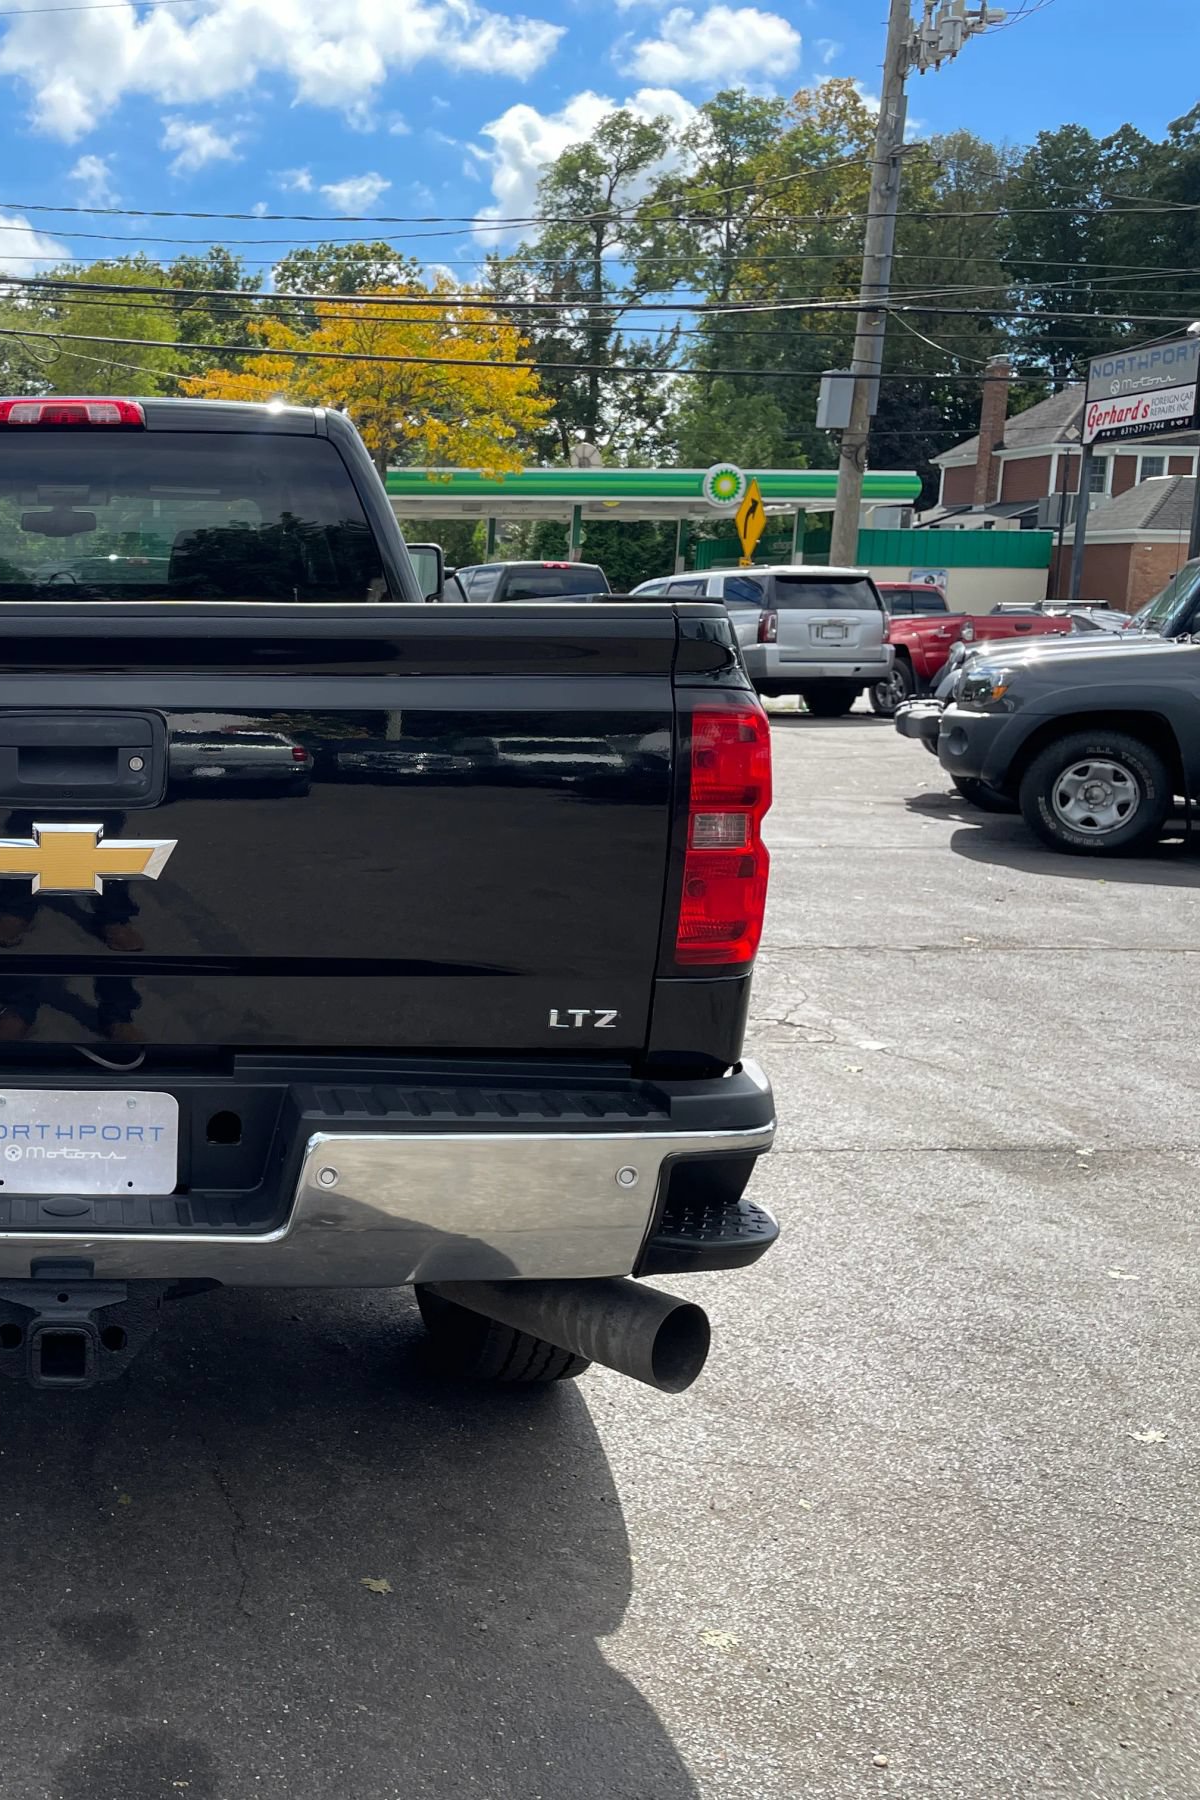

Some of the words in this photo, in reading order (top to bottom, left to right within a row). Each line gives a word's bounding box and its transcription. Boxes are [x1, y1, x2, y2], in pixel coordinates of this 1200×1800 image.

[1092, 341, 1200, 380] NORTHPORT
[1121, 375, 1176, 390] Motors
[1151, 393, 1179, 407] FOREIGN
[1180, 391, 1194, 402] CAR
[1087, 398, 1150, 436] Gerhard's
[1150, 404, 1176, 417] REPAIRS
[549, 1009, 618, 1028] LTZ
[25, 1146, 127, 1160] Motors
